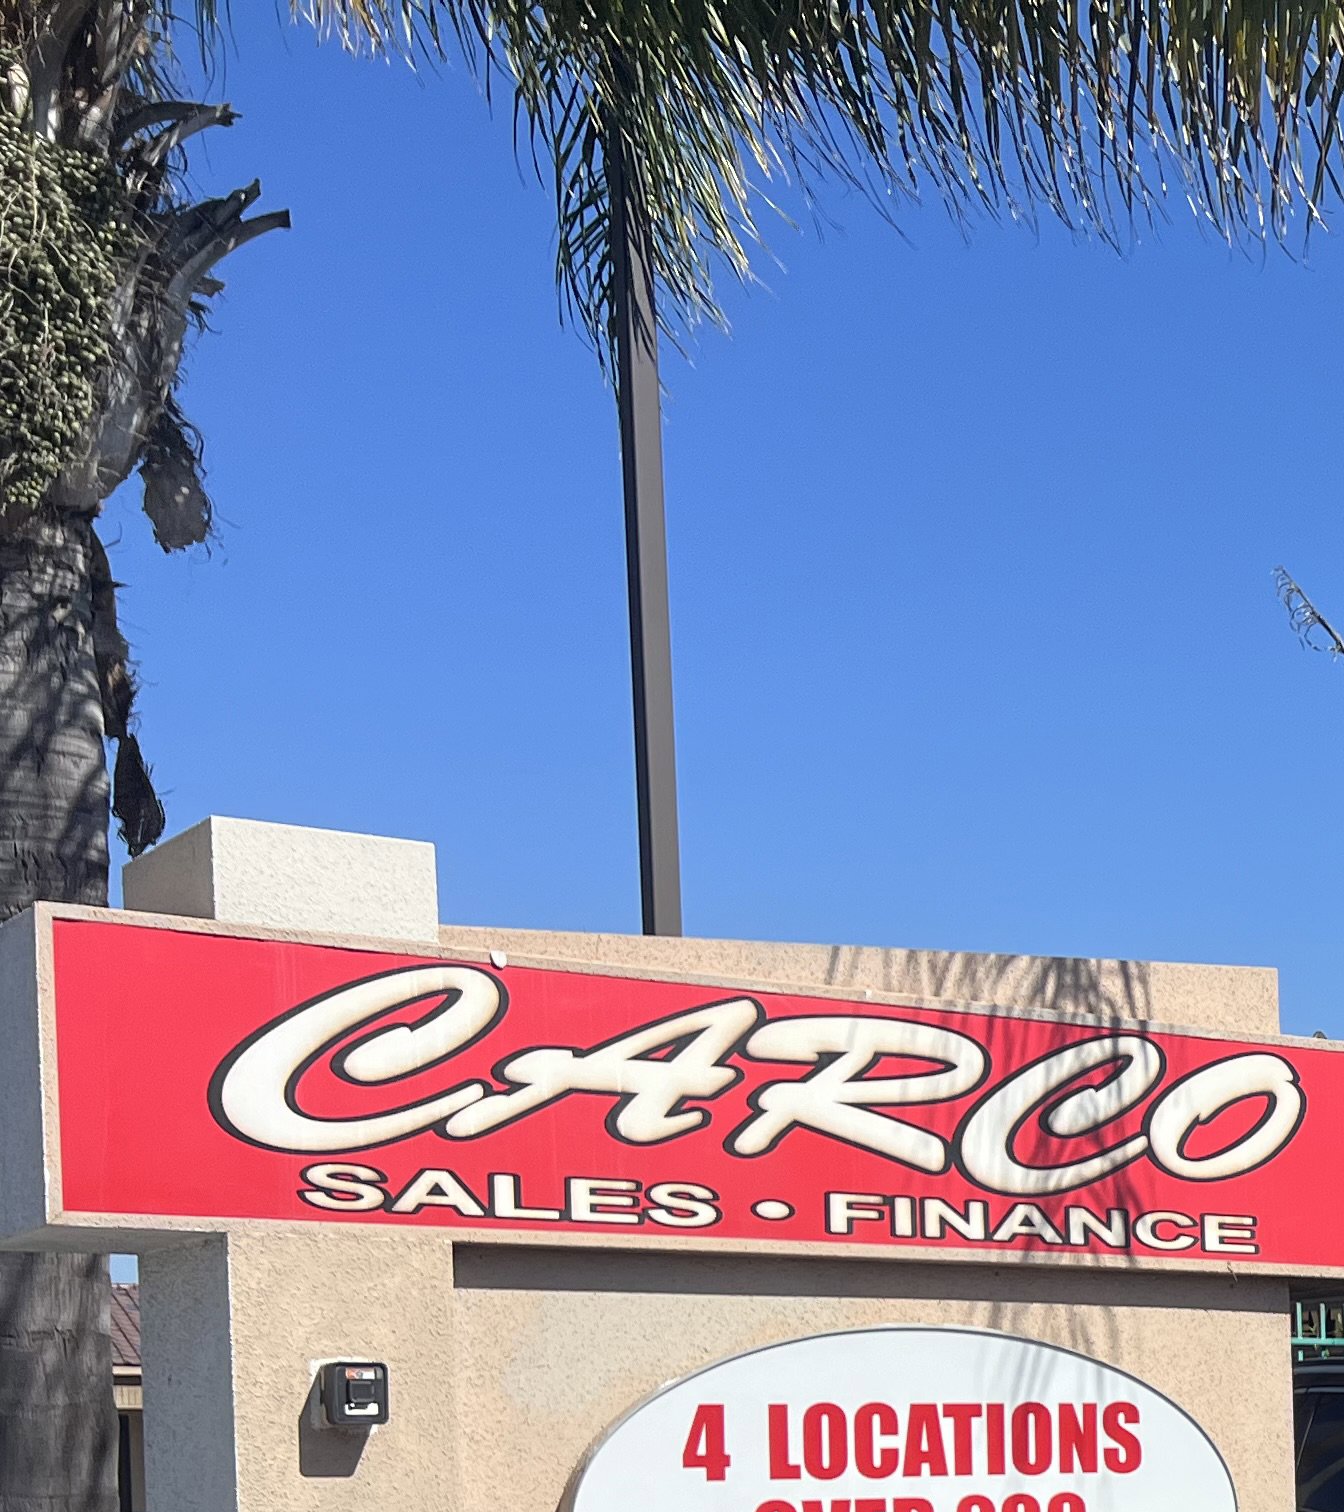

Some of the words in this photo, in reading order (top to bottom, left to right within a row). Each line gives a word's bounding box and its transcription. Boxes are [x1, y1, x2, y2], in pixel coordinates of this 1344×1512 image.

[206, 960, 1307, 1195] CARCO
[297, 1161, 720, 1229] SALES
[825, 1192, 1260, 1255] FINANCE
[682, 1403, 731, 1482] 4
[767, 1401, 1143, 1481] LOCATIONS
